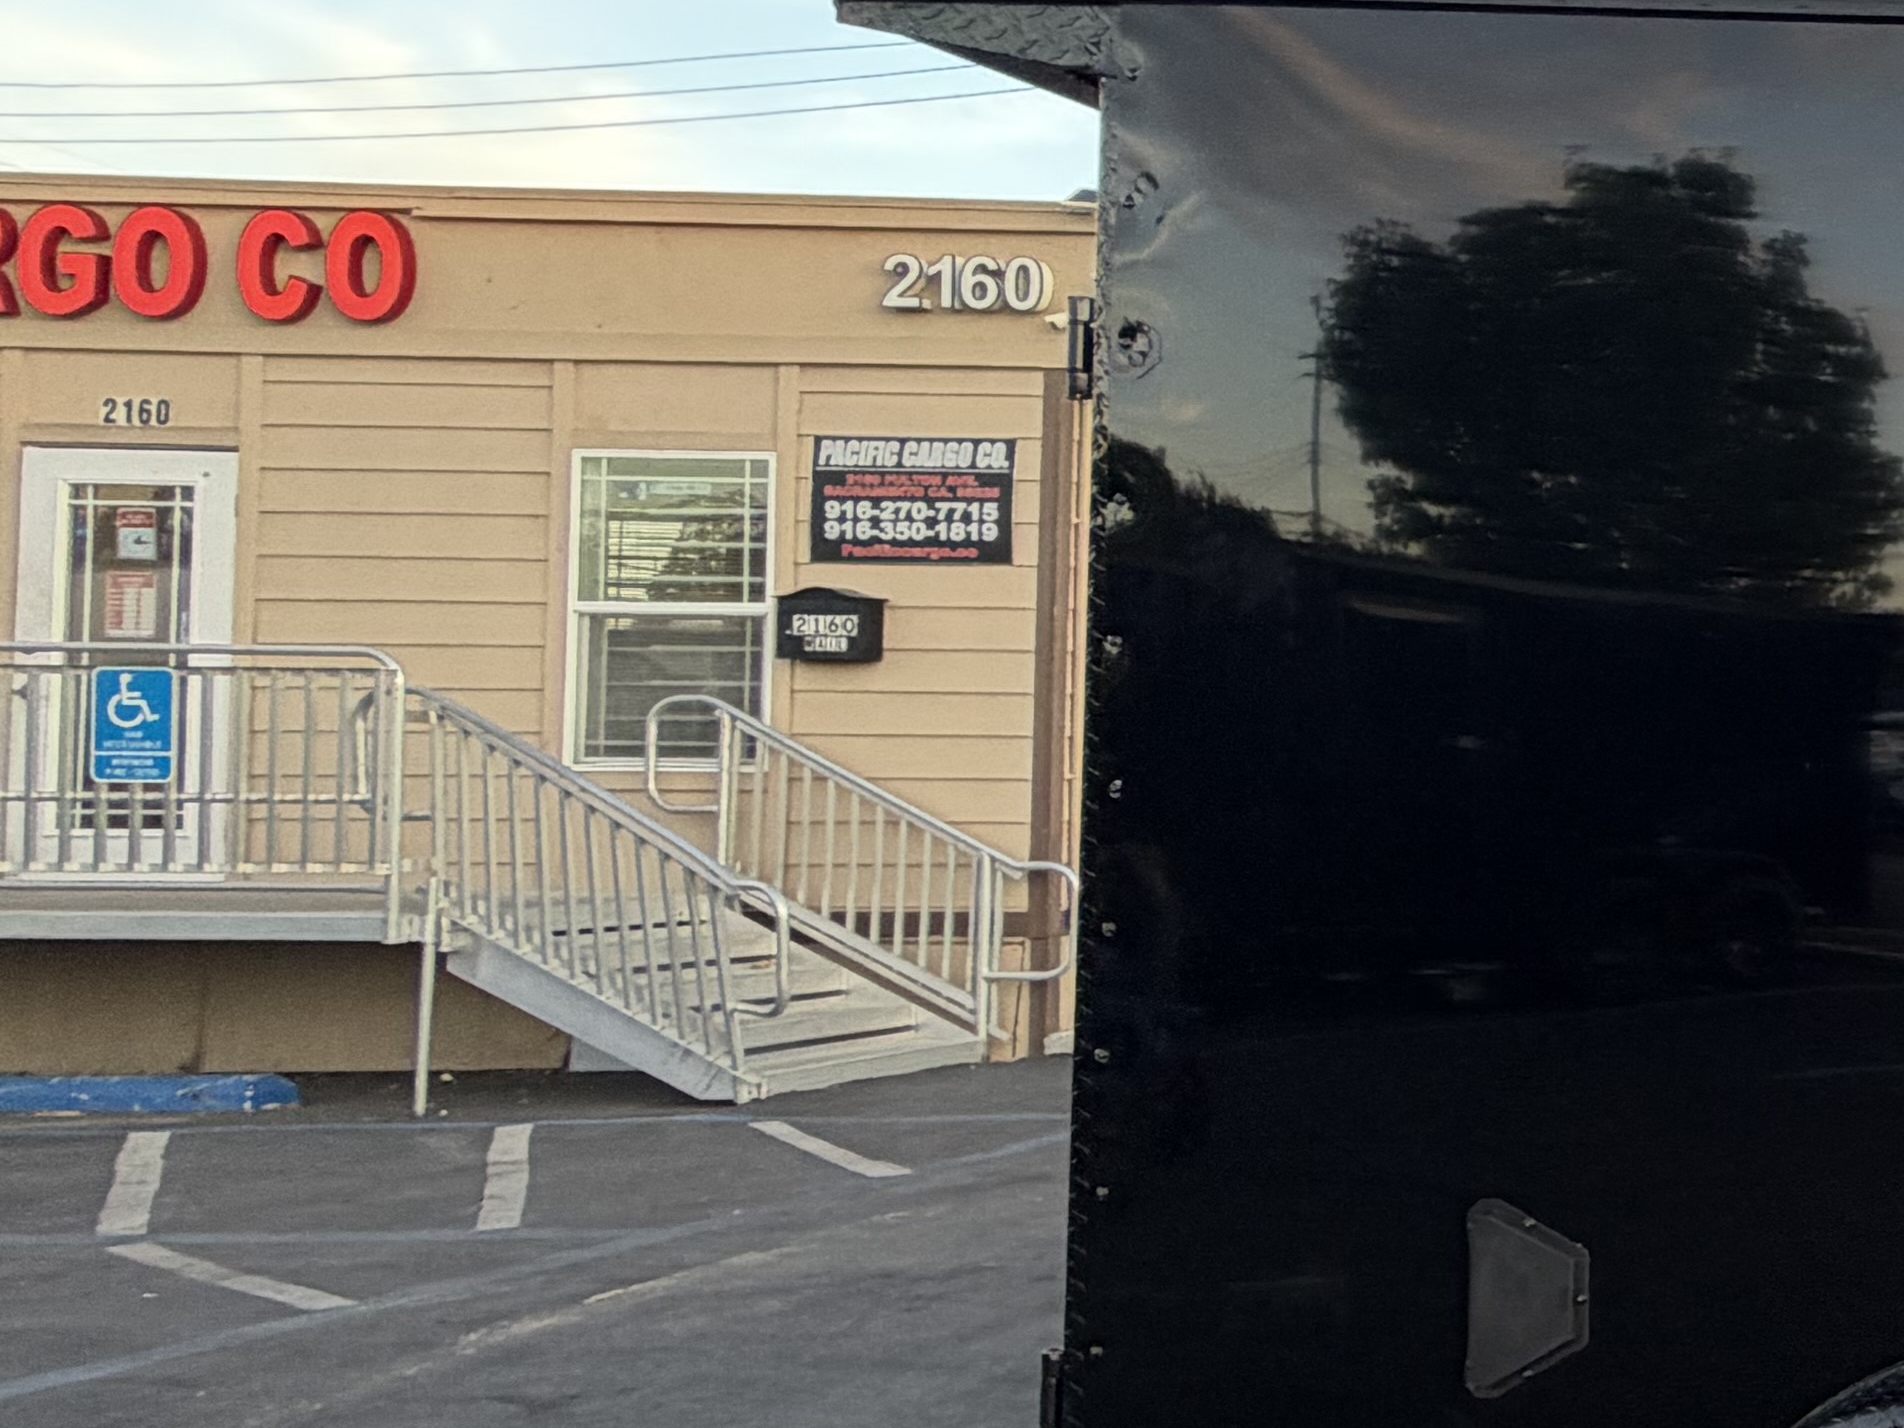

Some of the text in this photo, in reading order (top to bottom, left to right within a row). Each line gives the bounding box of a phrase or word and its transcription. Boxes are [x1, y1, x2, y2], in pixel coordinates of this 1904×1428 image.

[0, 204, 416, 324] GO CO
[882, 254, 1044, 311] 2160
[102, 398, 171, 425] 2160
[818, 439, 900, 466] PACIFIC
[902, 441, 974, 468] CARGO
[824, 500, 999, 521] 916-270-7715
[824, 521, 998, 541] 916-350-1819
[795, 616, 856, 634] 2160
